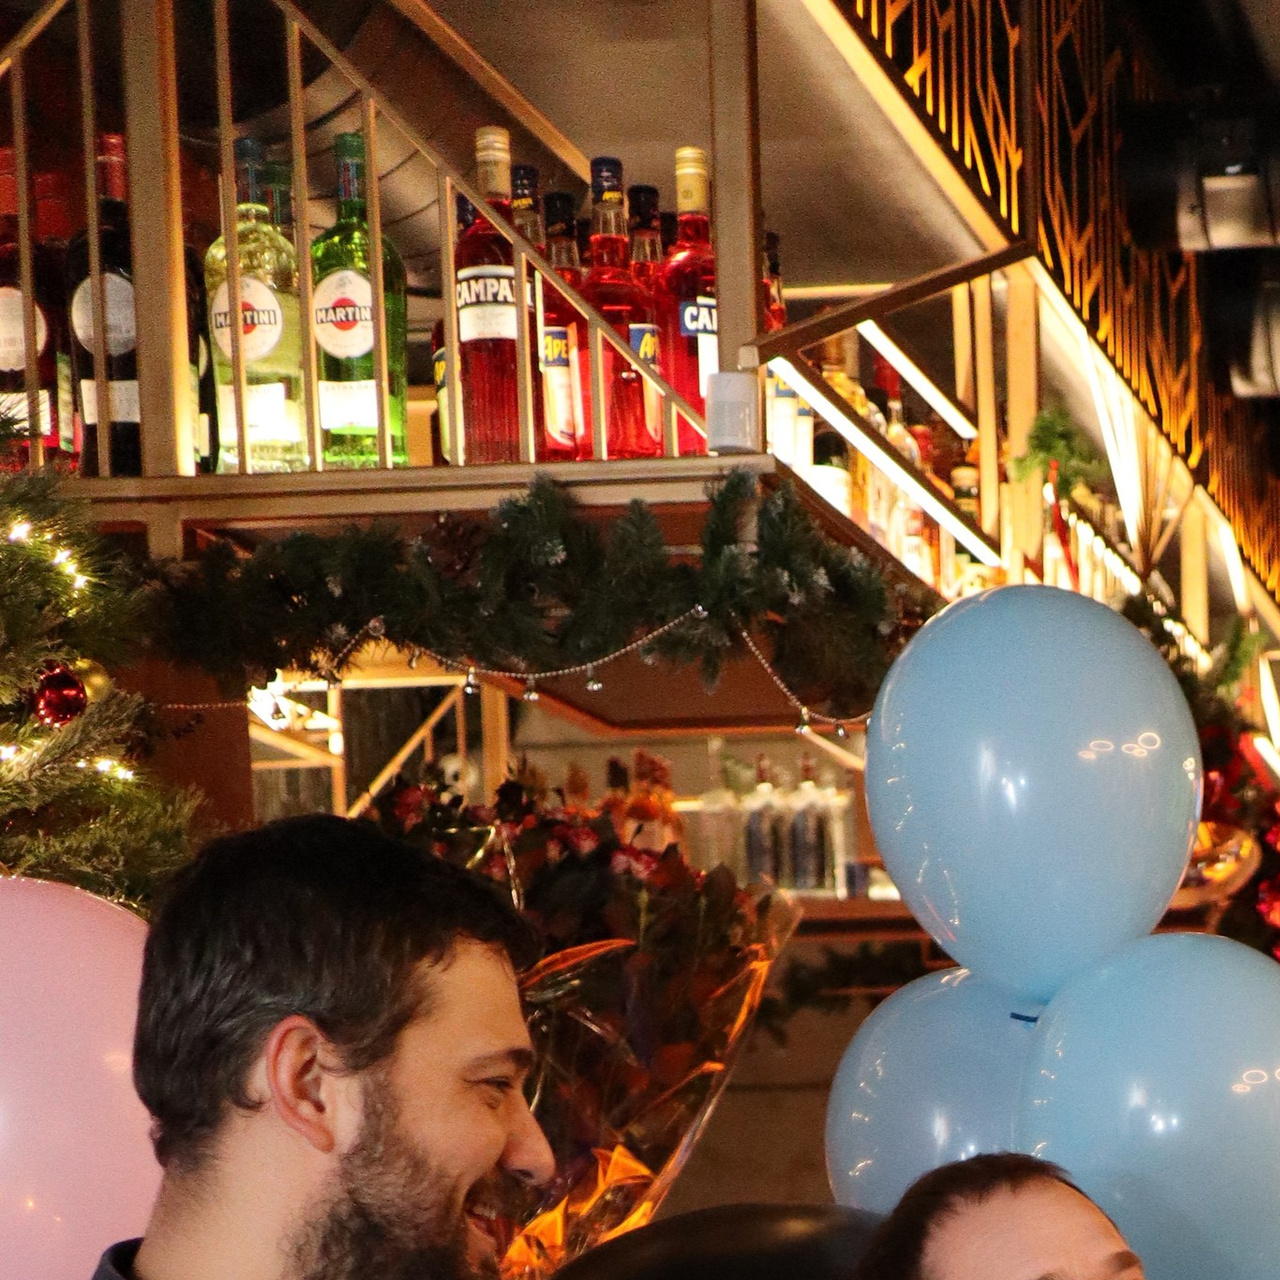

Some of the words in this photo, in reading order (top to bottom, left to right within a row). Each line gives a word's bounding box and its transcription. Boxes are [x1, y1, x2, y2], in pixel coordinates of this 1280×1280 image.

[456, 278, 535, 308] CAMPAI
[214, 309, 277, 329] MATINI
[315, 306, 372, 325] MARTIN
